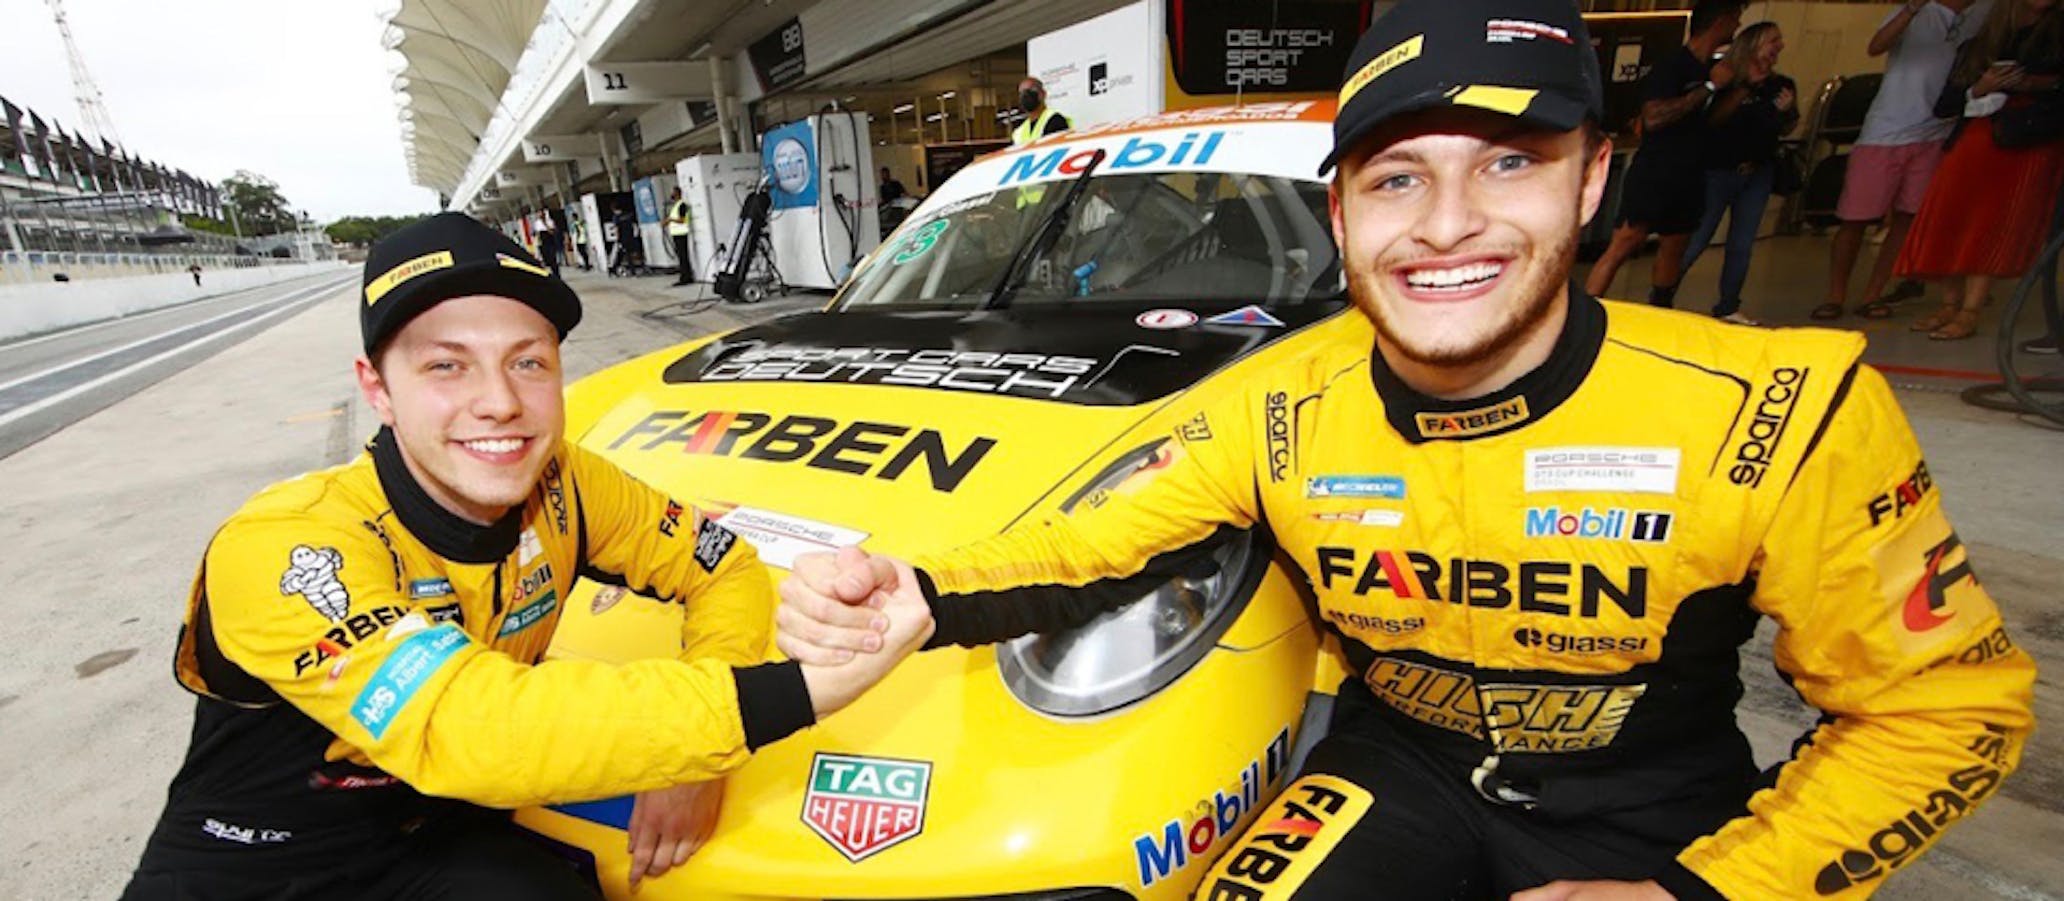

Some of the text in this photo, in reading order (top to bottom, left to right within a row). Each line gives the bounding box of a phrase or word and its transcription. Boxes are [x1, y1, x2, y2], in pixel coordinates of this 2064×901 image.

[1226, 29, 1333, 46] DEUTSCH
[1226, 49, 1302, 66] SPORT
[1352, 46, 1410, 88] FARBEN
[603, 73, 627, 90] 11
[1226, 68, 1287, 85] CARS
[535, 144, 551, 155] 10
[999, 131, 1226, 185] Mobil
[389, 256, 444, 283] FARBEN
[742, 346, 1098, 375] SPORT CARS
[704, 361, 1078, 397] DEUTSCH
[1425, 404, 1519, 431] FARBEN
[1729, 368, 1802, 486] sparco
[606, 410, 998, 494] FARBEN
[1535, 453, 1657, 463] PORSCHE
[1556, 470, 1575, 478] CUP
[1578, 470, 1635, 478] CHALLENGE
[733, 511, 835, 542] PORSCHE
[1527, 508, 1625, 538] Mobil
[1316, 548, 1648, 619] FARBEN
[1349, 613, 1426, 634] giassi
[1546, 631, 1648, 653] giassi
[825, 761, 917, 797] TAG
[811, 799, 914, 848] HEUER
[1136, 761, 1259, 885] Mobil
